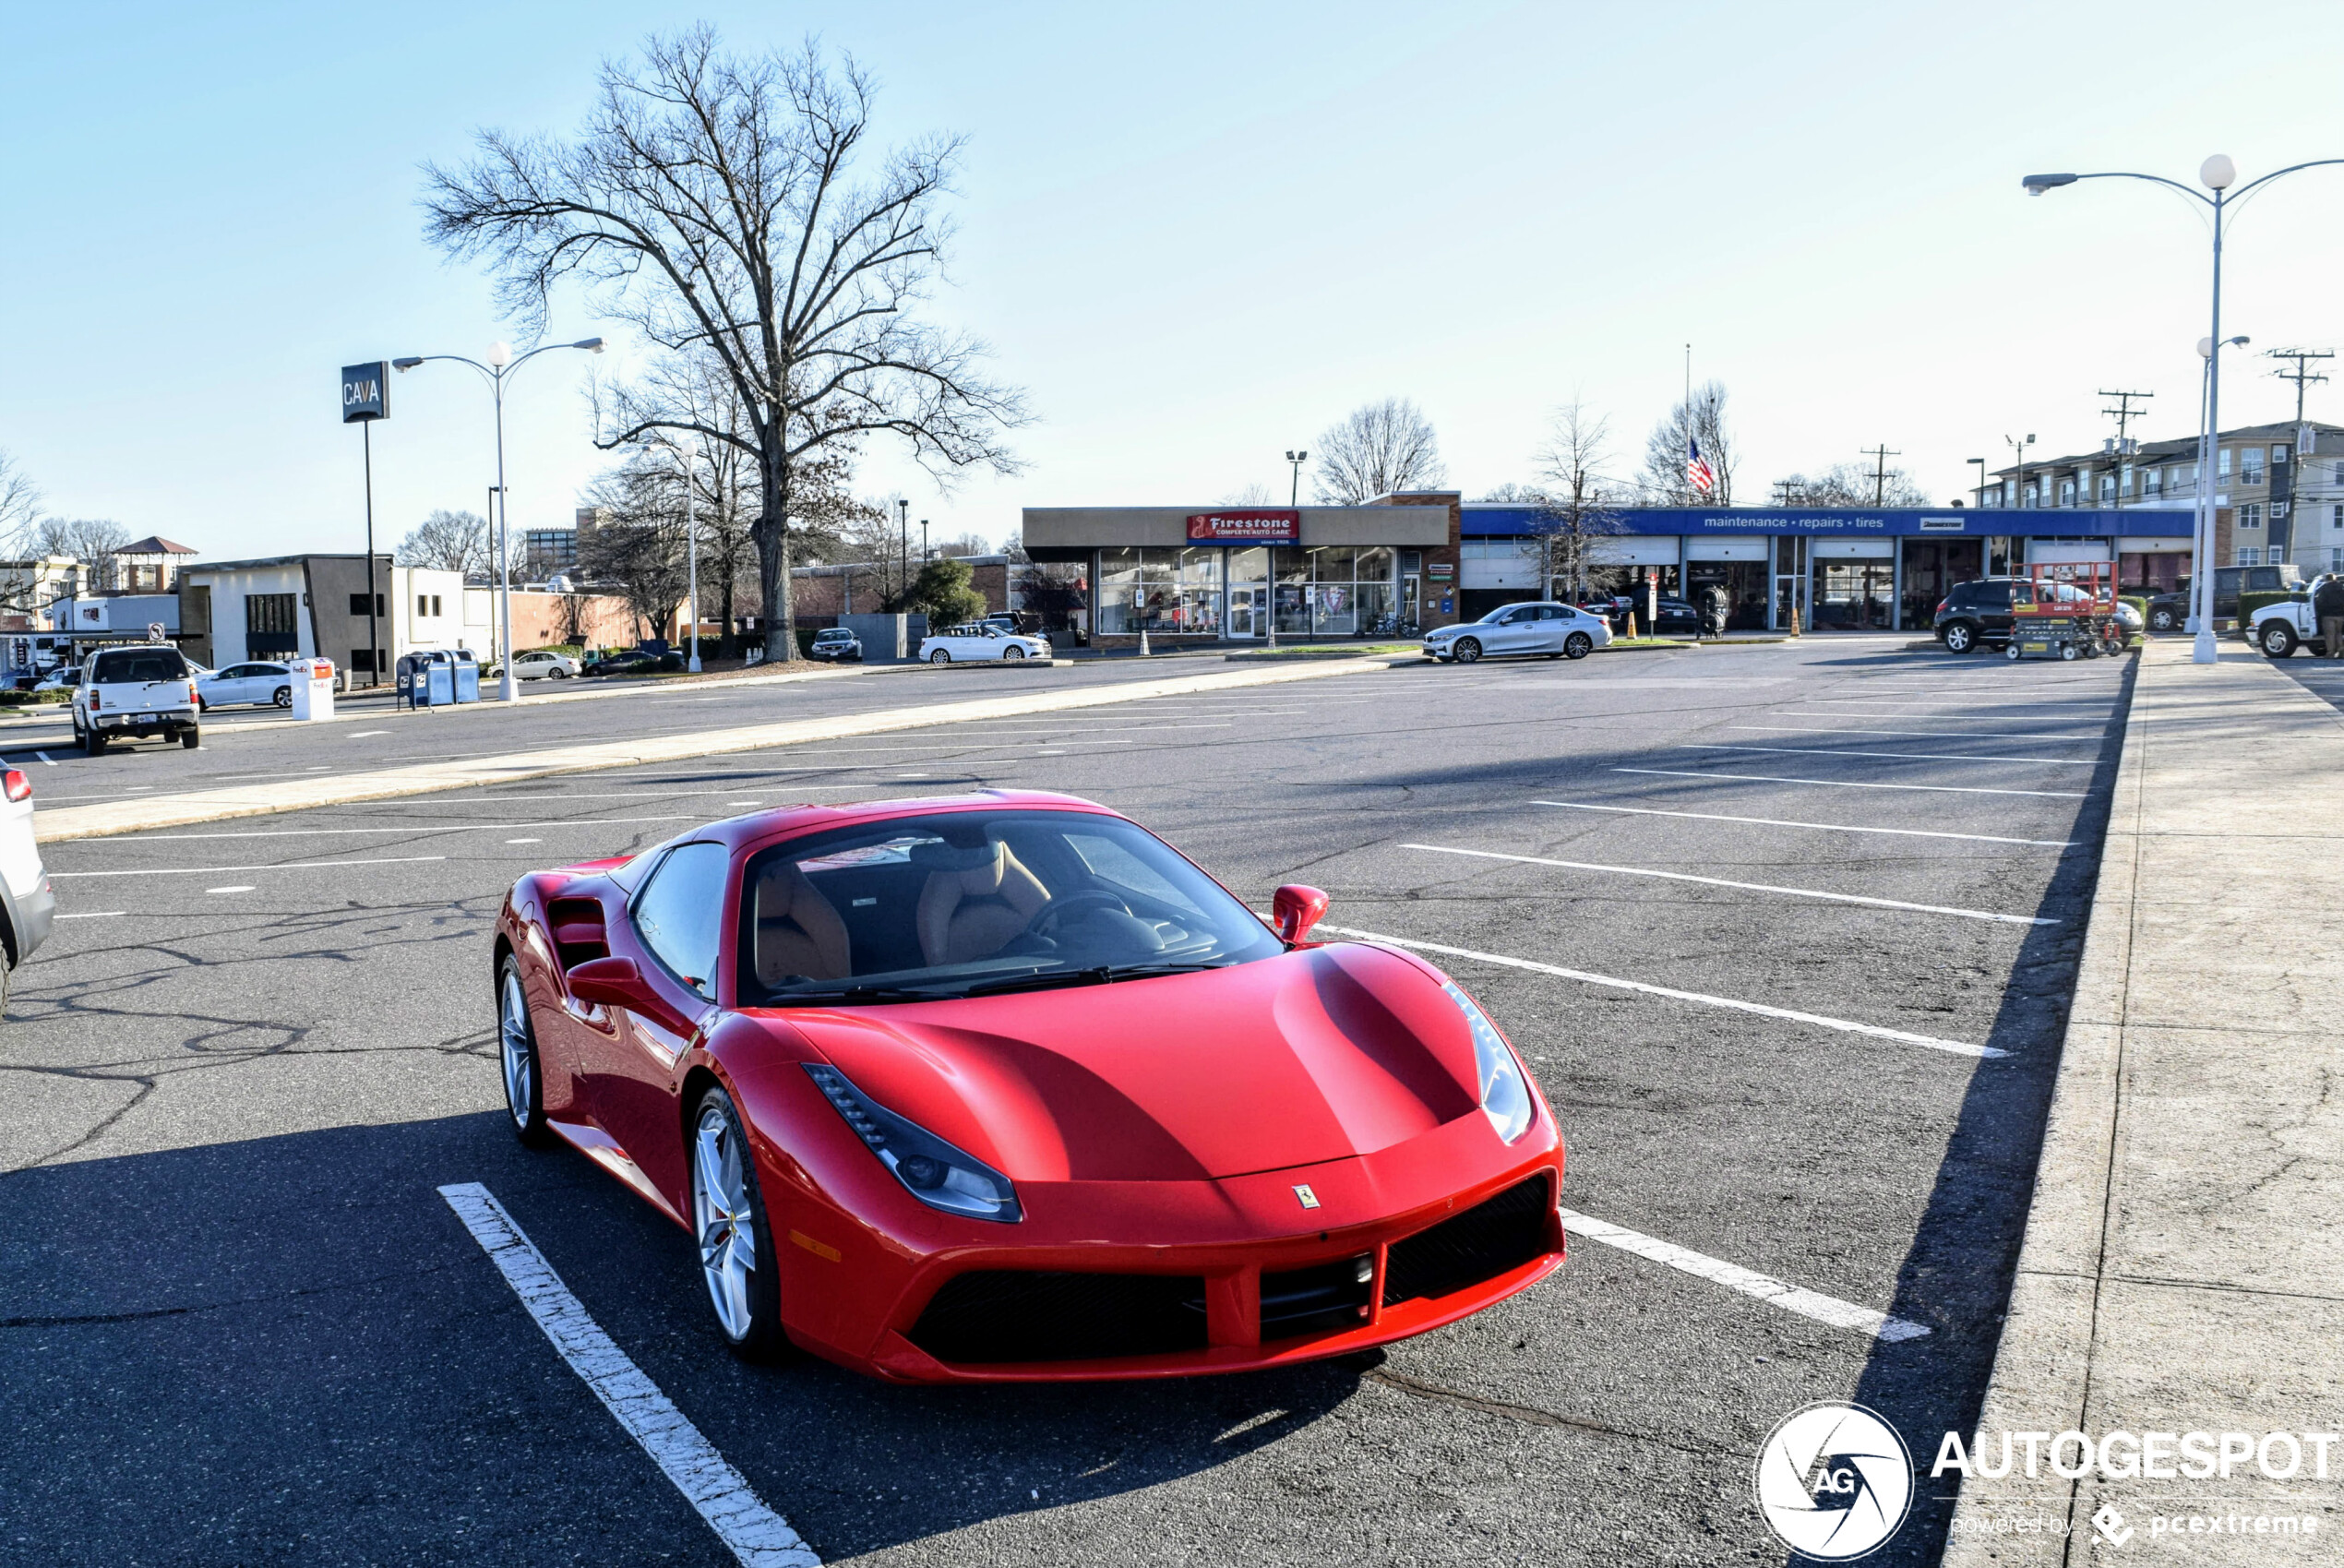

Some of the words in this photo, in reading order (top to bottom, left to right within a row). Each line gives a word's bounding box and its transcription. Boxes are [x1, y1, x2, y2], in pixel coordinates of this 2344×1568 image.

[344, 379, 379, 405] CAVA
[1210, 518, 1290, 529] Firestone
[1704, 517, 1788, 527] maintenance
[1800, 517, 1844, 529] repairs
[1856, 517, 1884, 527] tires
